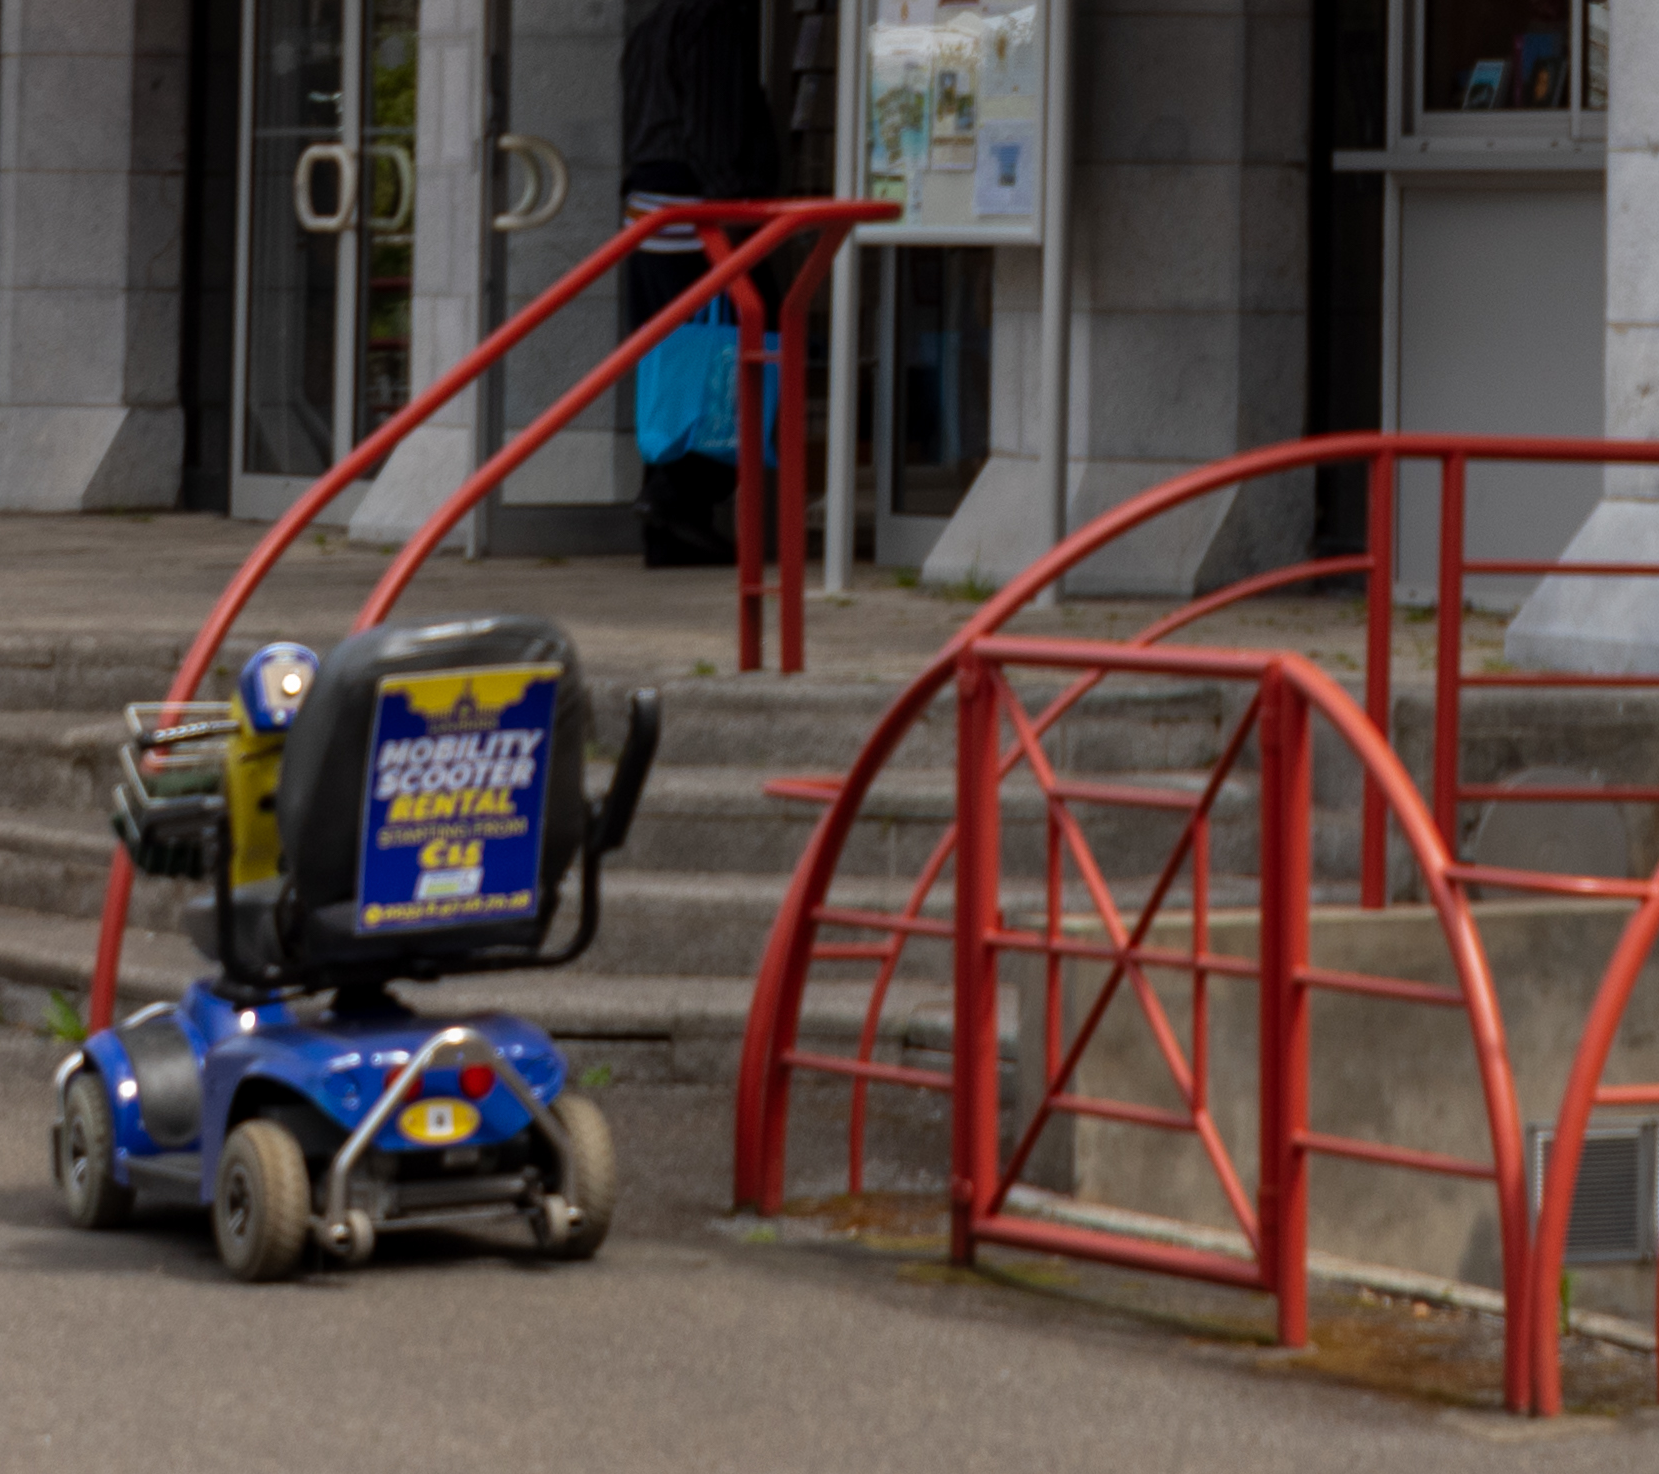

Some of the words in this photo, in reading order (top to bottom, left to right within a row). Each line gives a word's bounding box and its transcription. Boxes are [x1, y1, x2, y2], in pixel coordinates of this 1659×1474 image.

[377, 728, 544, 770] MOBILITY
[375, 757, 536, 799] SCOOTER
[389, 788, 515, 822] RENTAL
